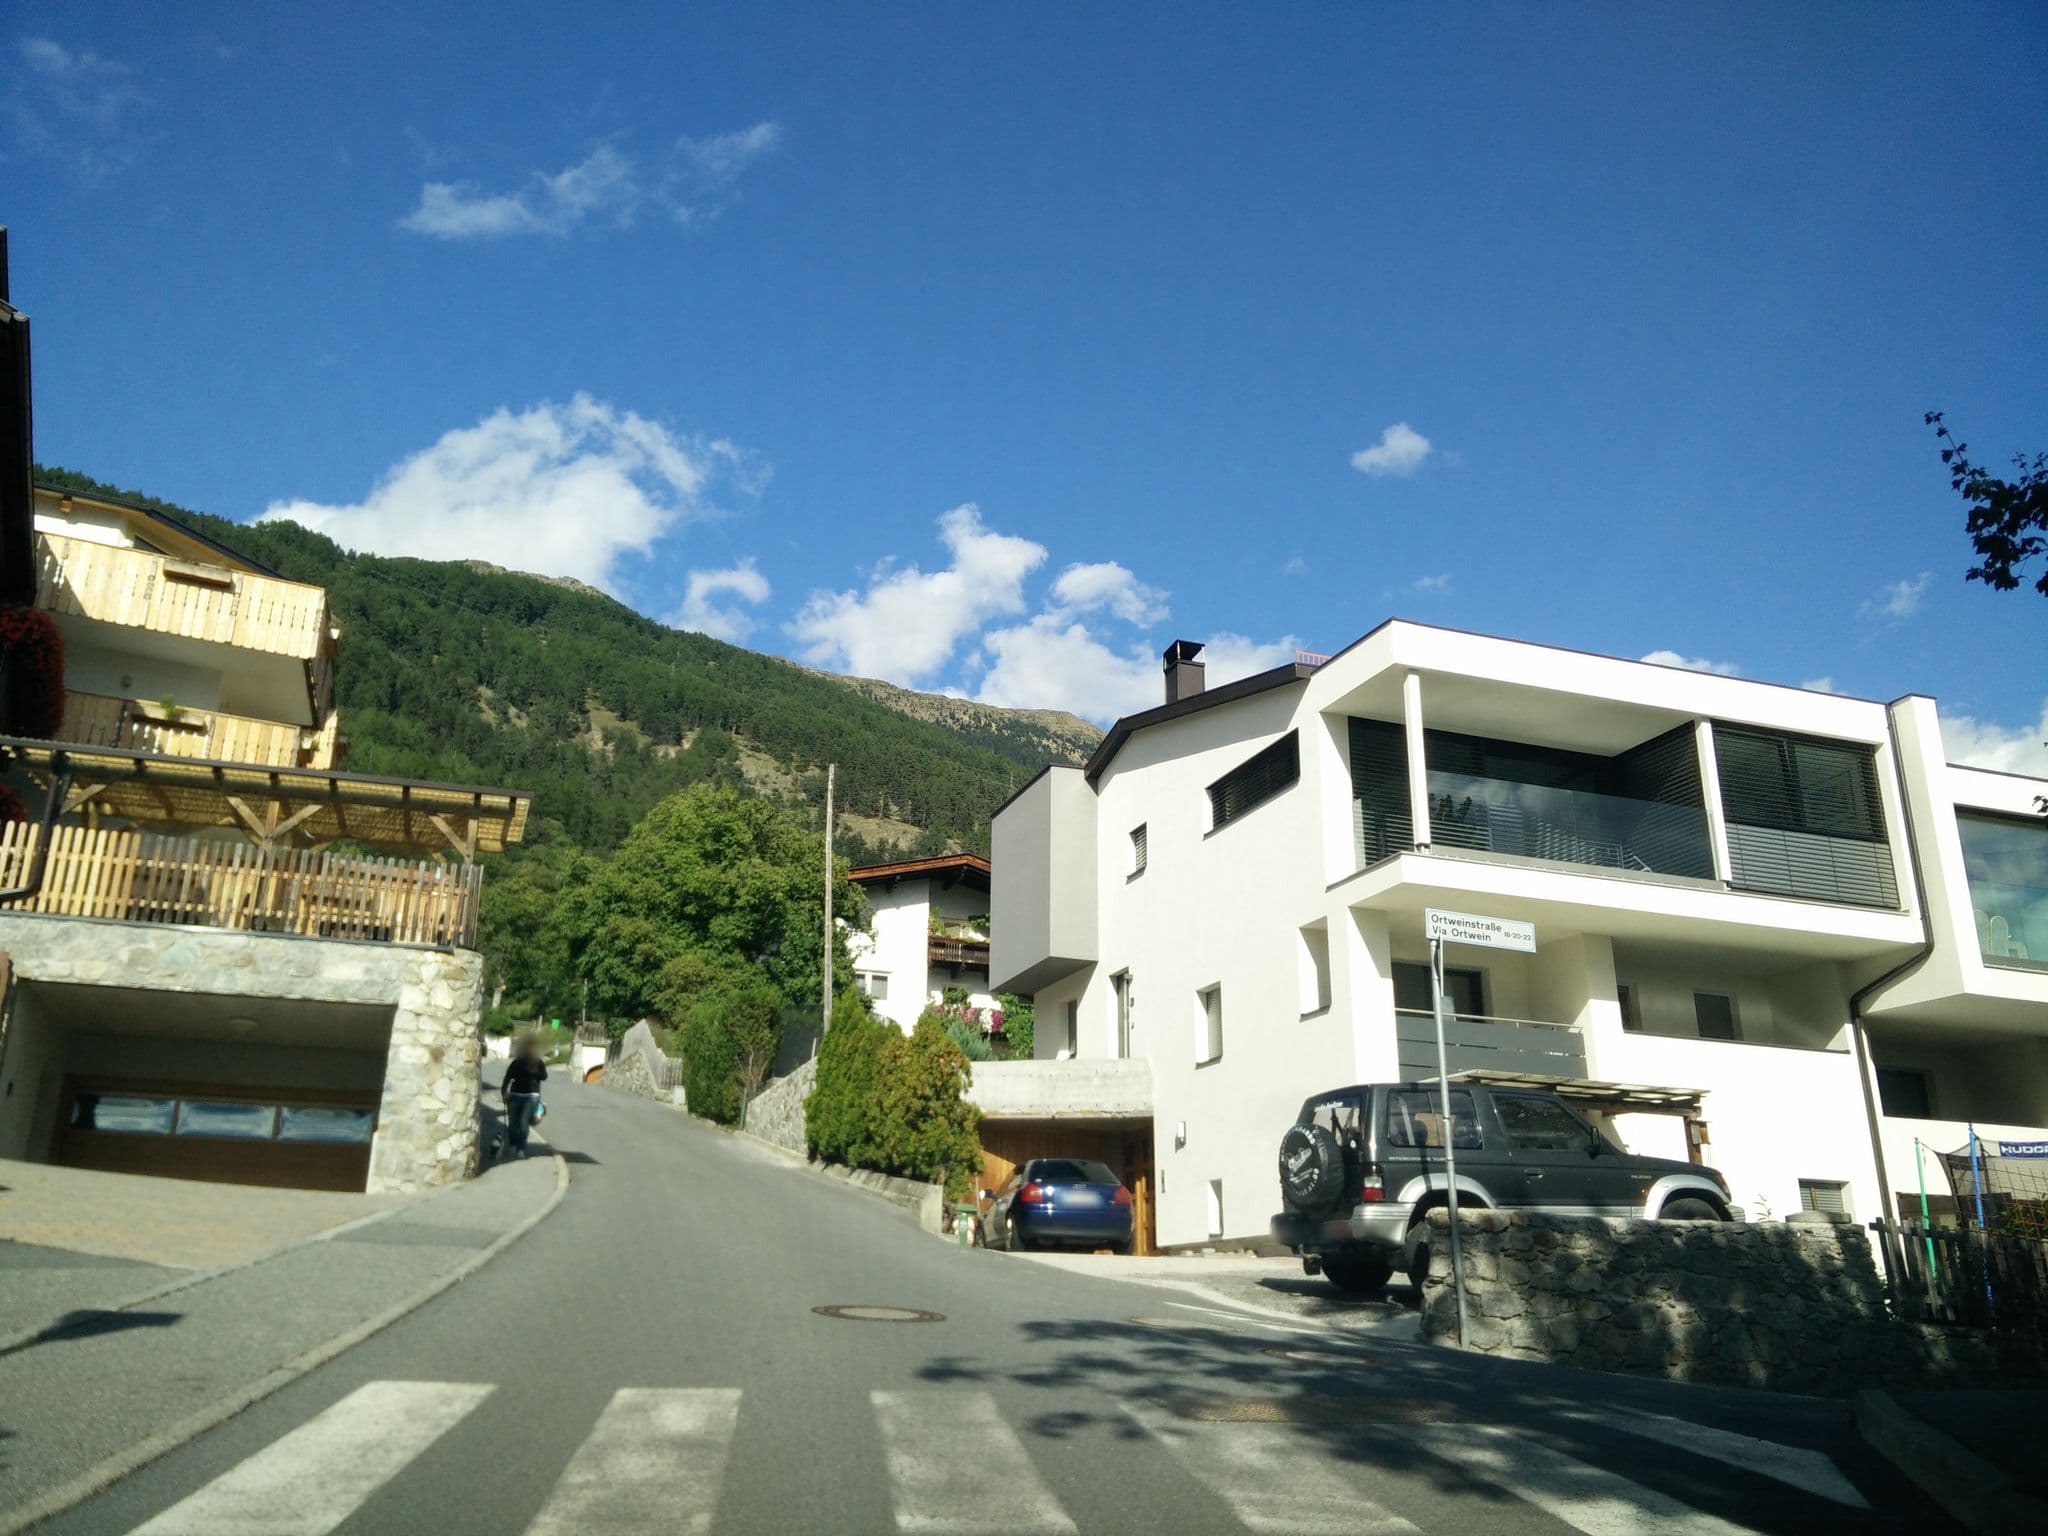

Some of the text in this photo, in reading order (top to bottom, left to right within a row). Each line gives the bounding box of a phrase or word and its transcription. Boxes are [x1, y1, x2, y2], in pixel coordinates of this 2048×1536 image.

[1431, 914, 1502, 932] Ortweinstraße
[1432, 925, 1492, 941] Via Ortwein
